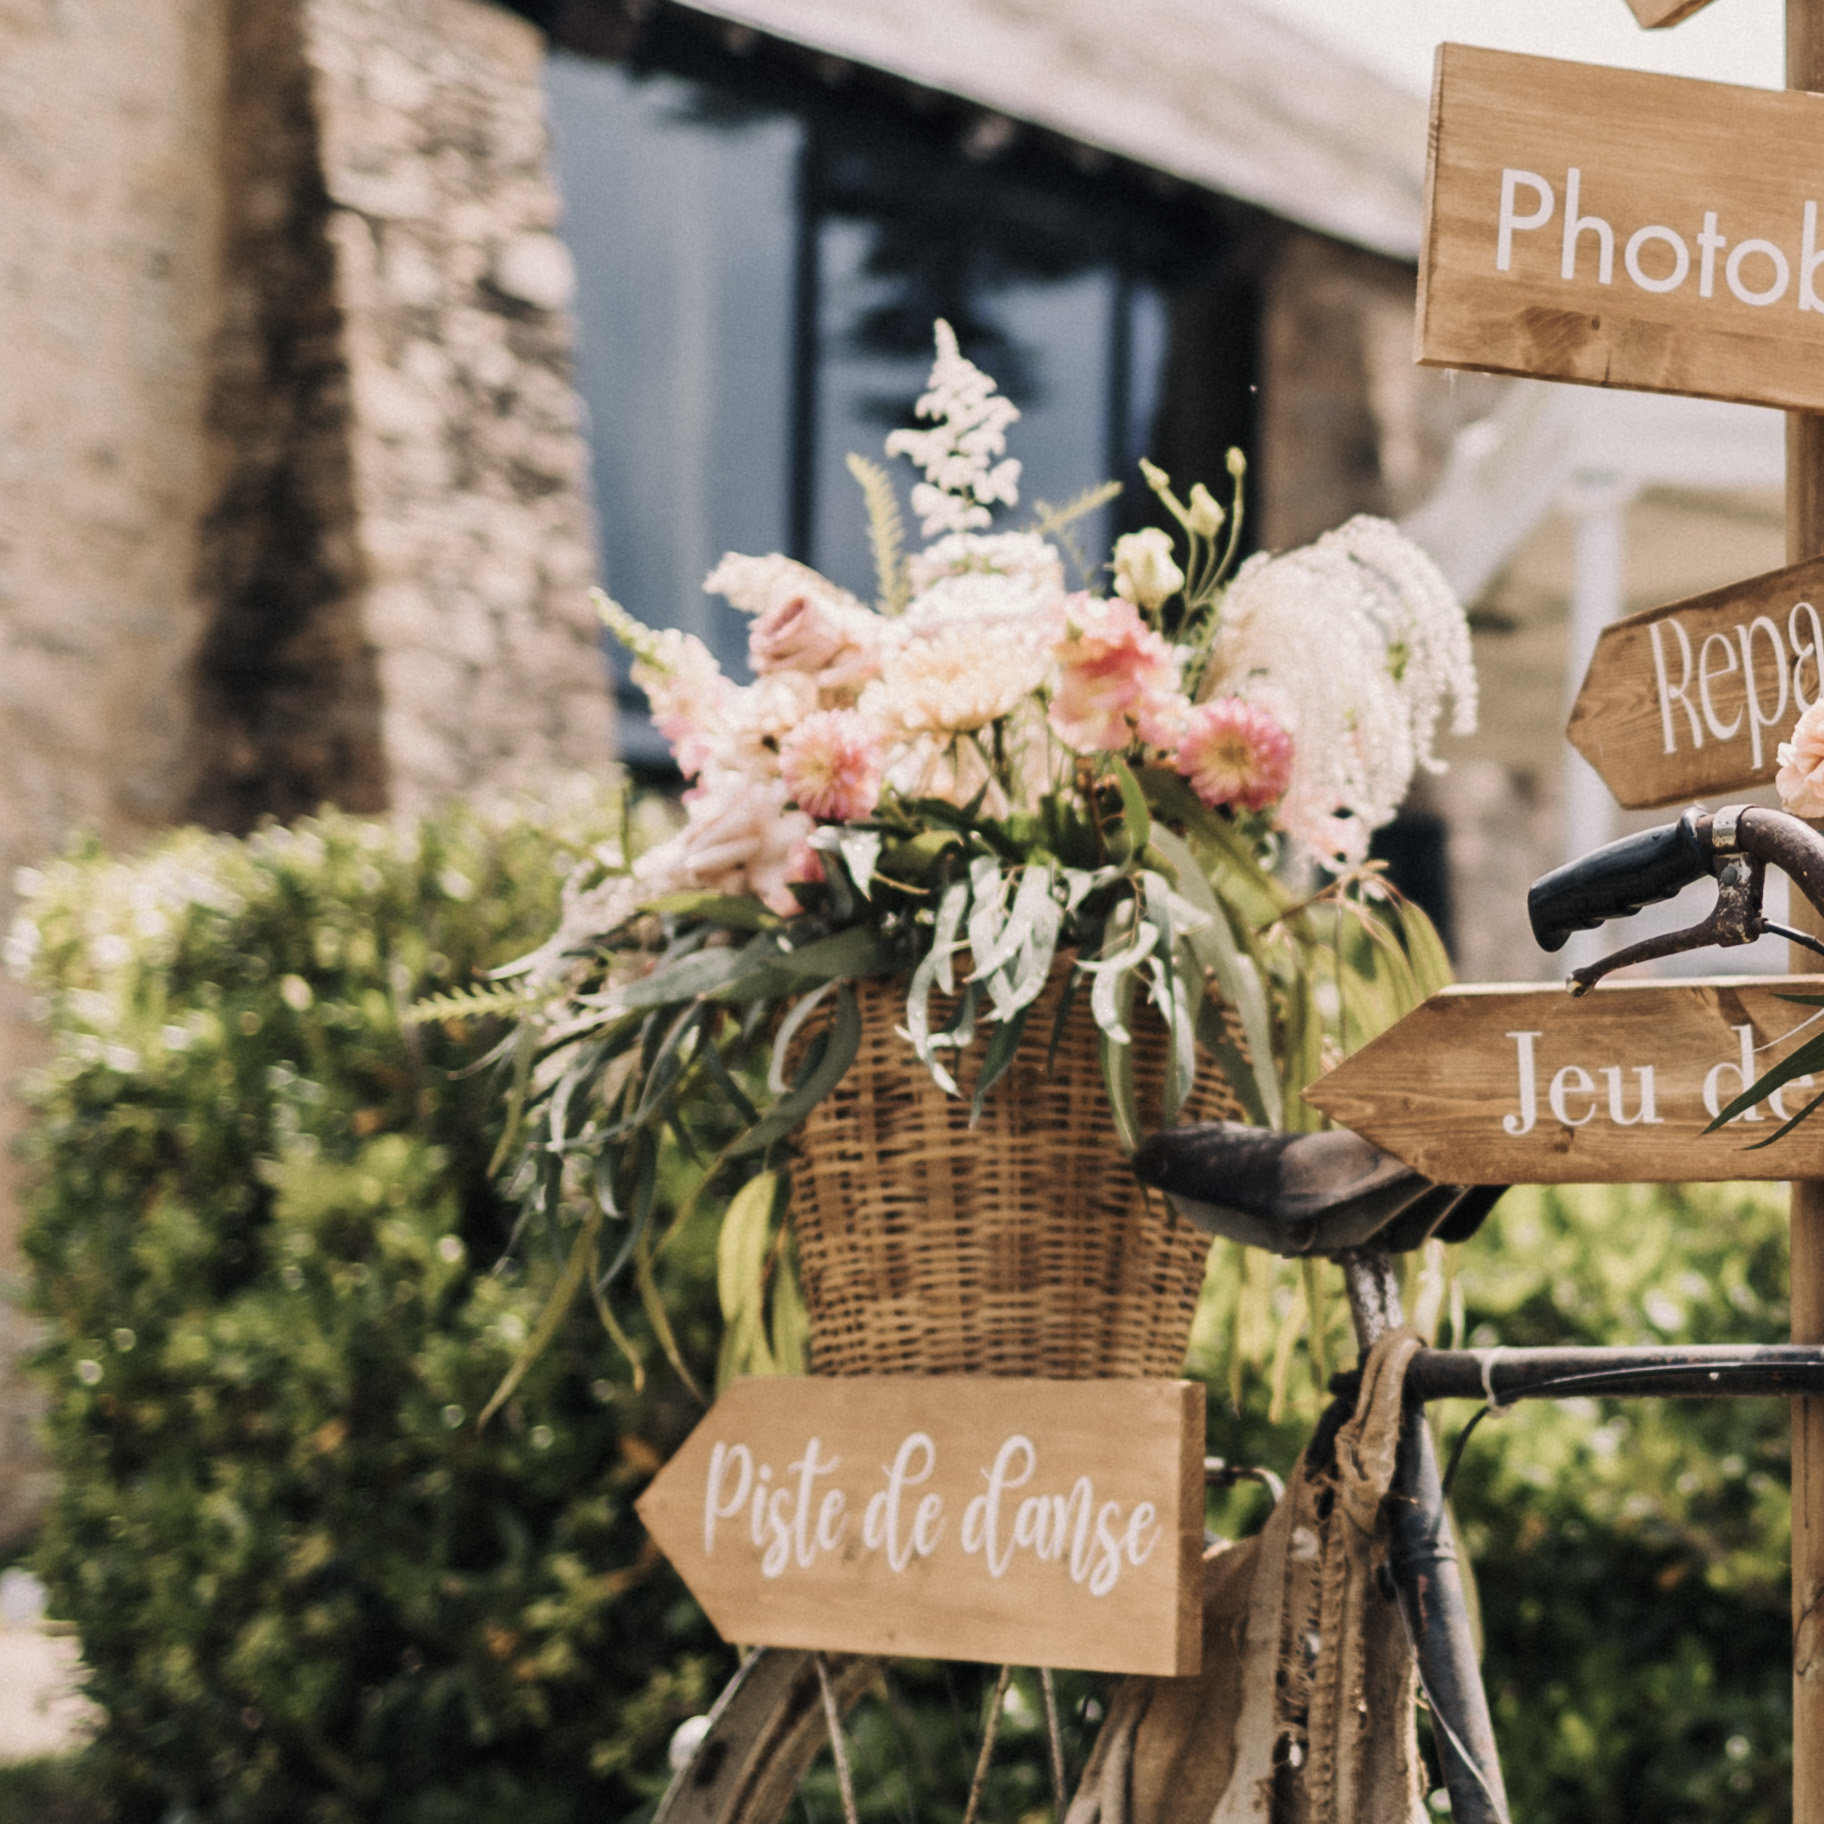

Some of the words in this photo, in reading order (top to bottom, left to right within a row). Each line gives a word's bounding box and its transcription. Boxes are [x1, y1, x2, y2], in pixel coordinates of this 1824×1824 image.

[1502, 1029, 1666, 1136] Jeu
[704, 1437, 852, 1579] Piste
[862, 1431, 947, 1574] de
[960, 1433, 1164, 1596] danse
